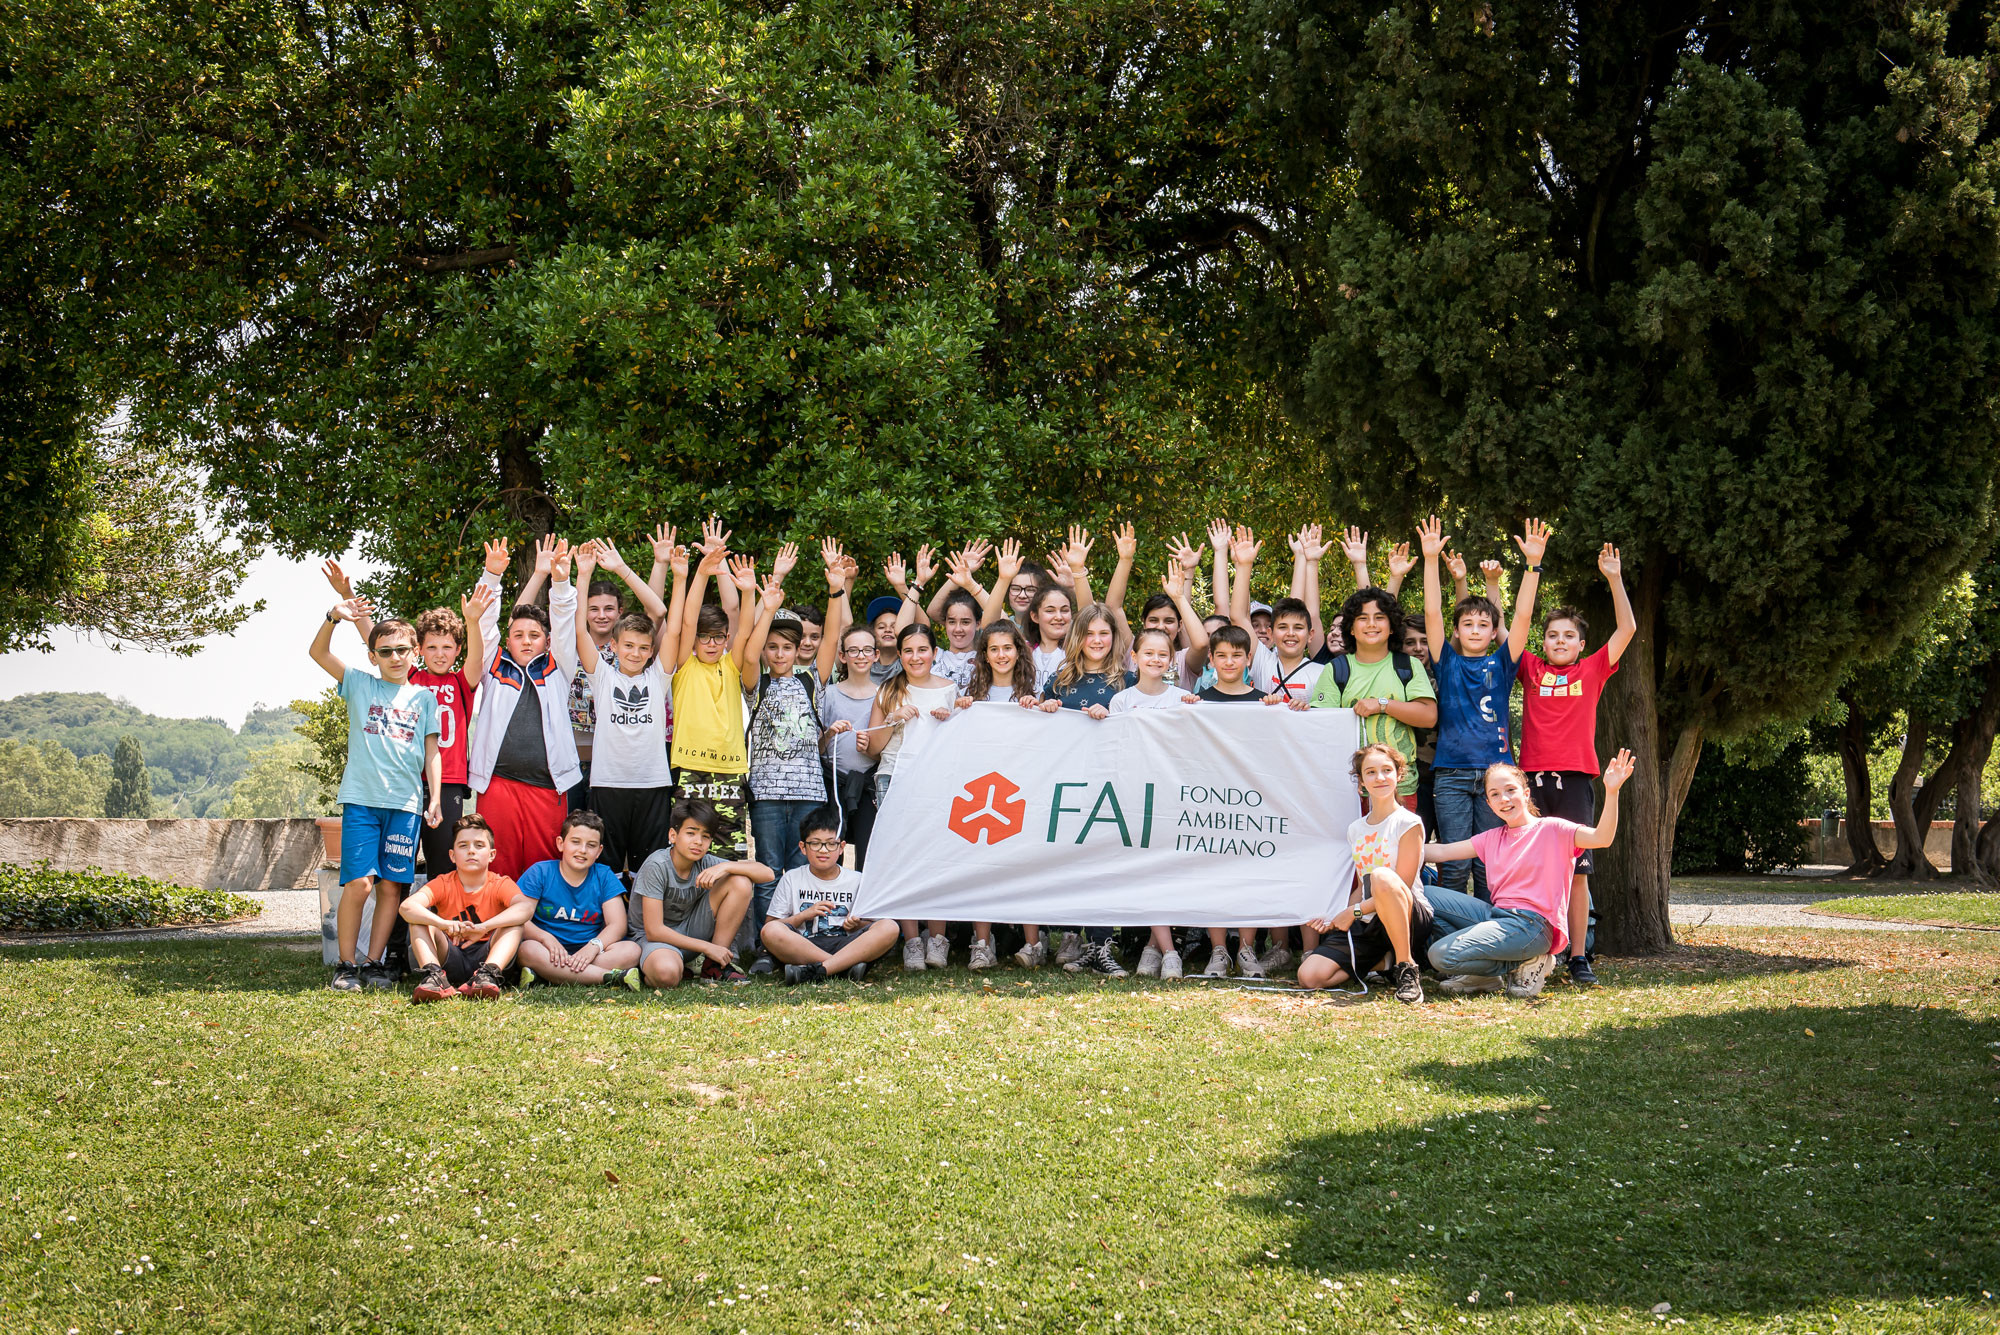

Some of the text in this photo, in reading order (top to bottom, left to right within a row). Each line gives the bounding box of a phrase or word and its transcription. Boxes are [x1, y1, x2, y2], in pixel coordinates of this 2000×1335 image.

[429, 684, 455, 704] T'S
[610, 712, 653, 724] adidas
[677, 746, 741, 762] RICHMOND
[683, 783, 741, 800] PYREX
[1179, 785, 1263, 807] FONDO
[1046, 781, 1154, 849] FAI
[1177, 810, 1289, 834] AMBIENTE
[1175, 834, 1276, 858] ITALIANO
[798, 888, 853, 903] WHATEVER
[535, 905, 599, 925] ITALIA
